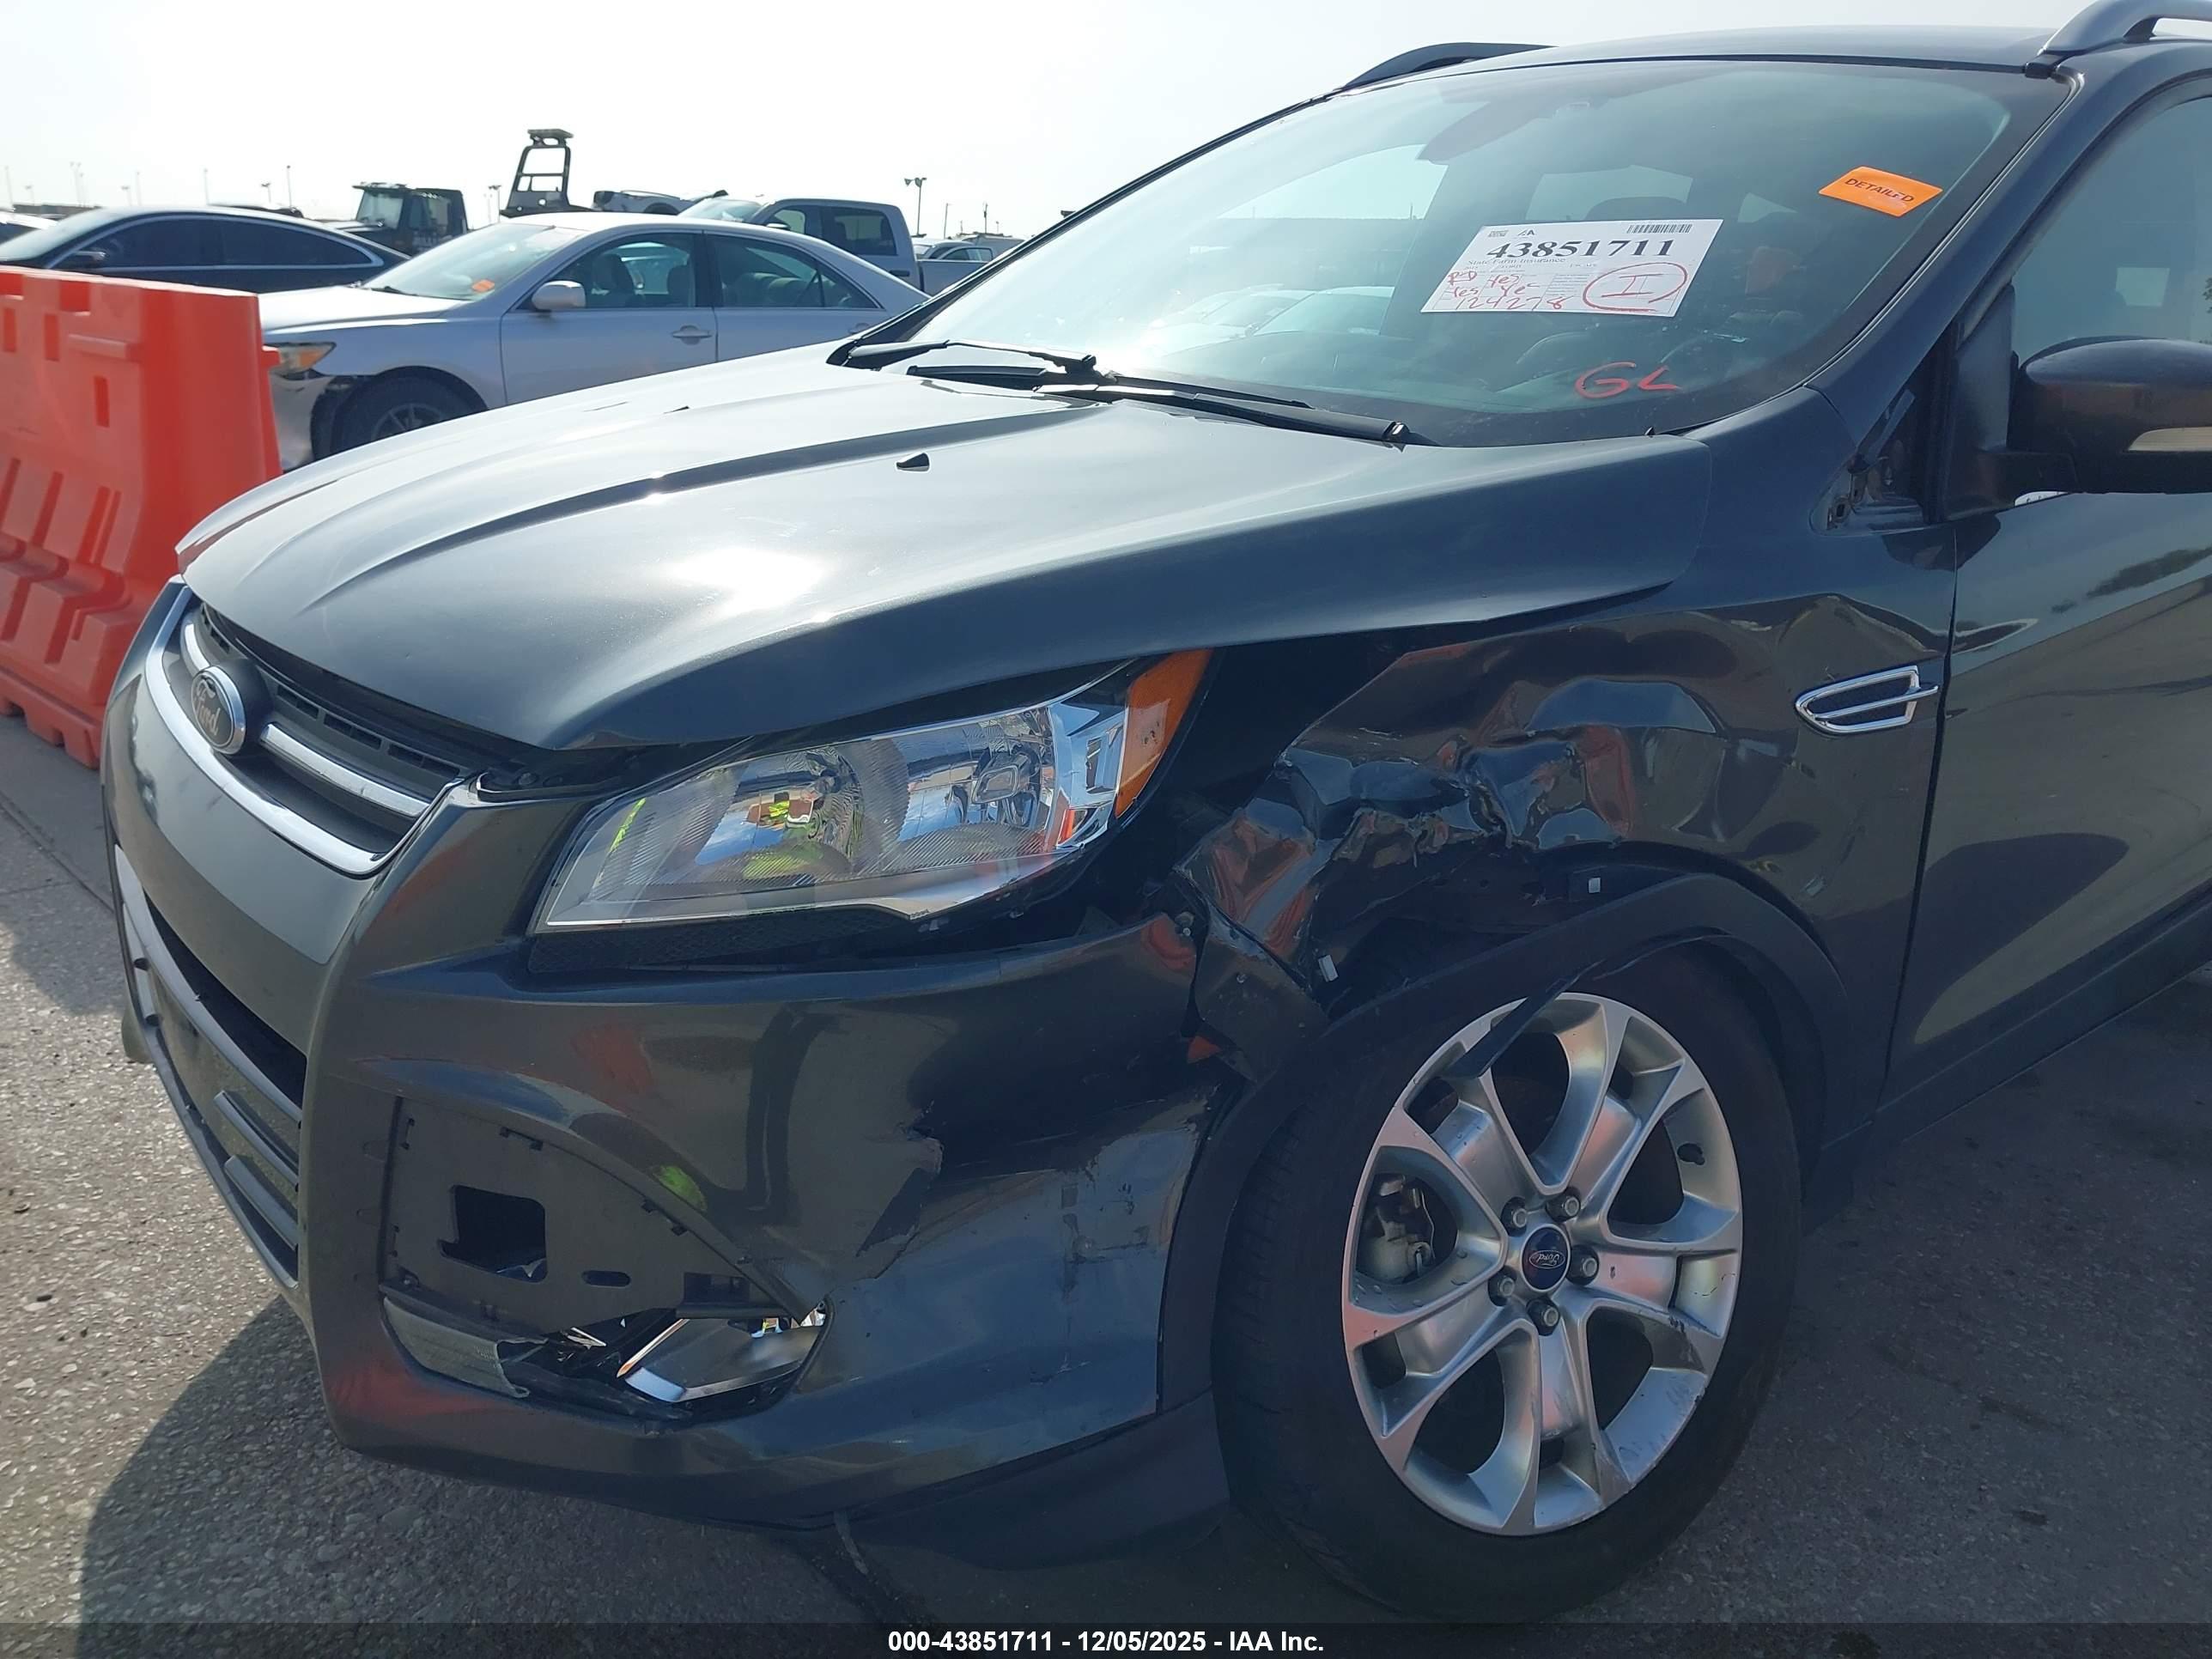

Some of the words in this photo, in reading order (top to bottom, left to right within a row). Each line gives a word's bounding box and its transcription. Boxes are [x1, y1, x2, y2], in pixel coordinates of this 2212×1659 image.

[1844, 178, 1916, 202] DETAILED
[1487, 239, 1674, 258] 43851711
[193, 675, 222, 736] Ford
[1535, 1253, 1560, 1267] Ford
